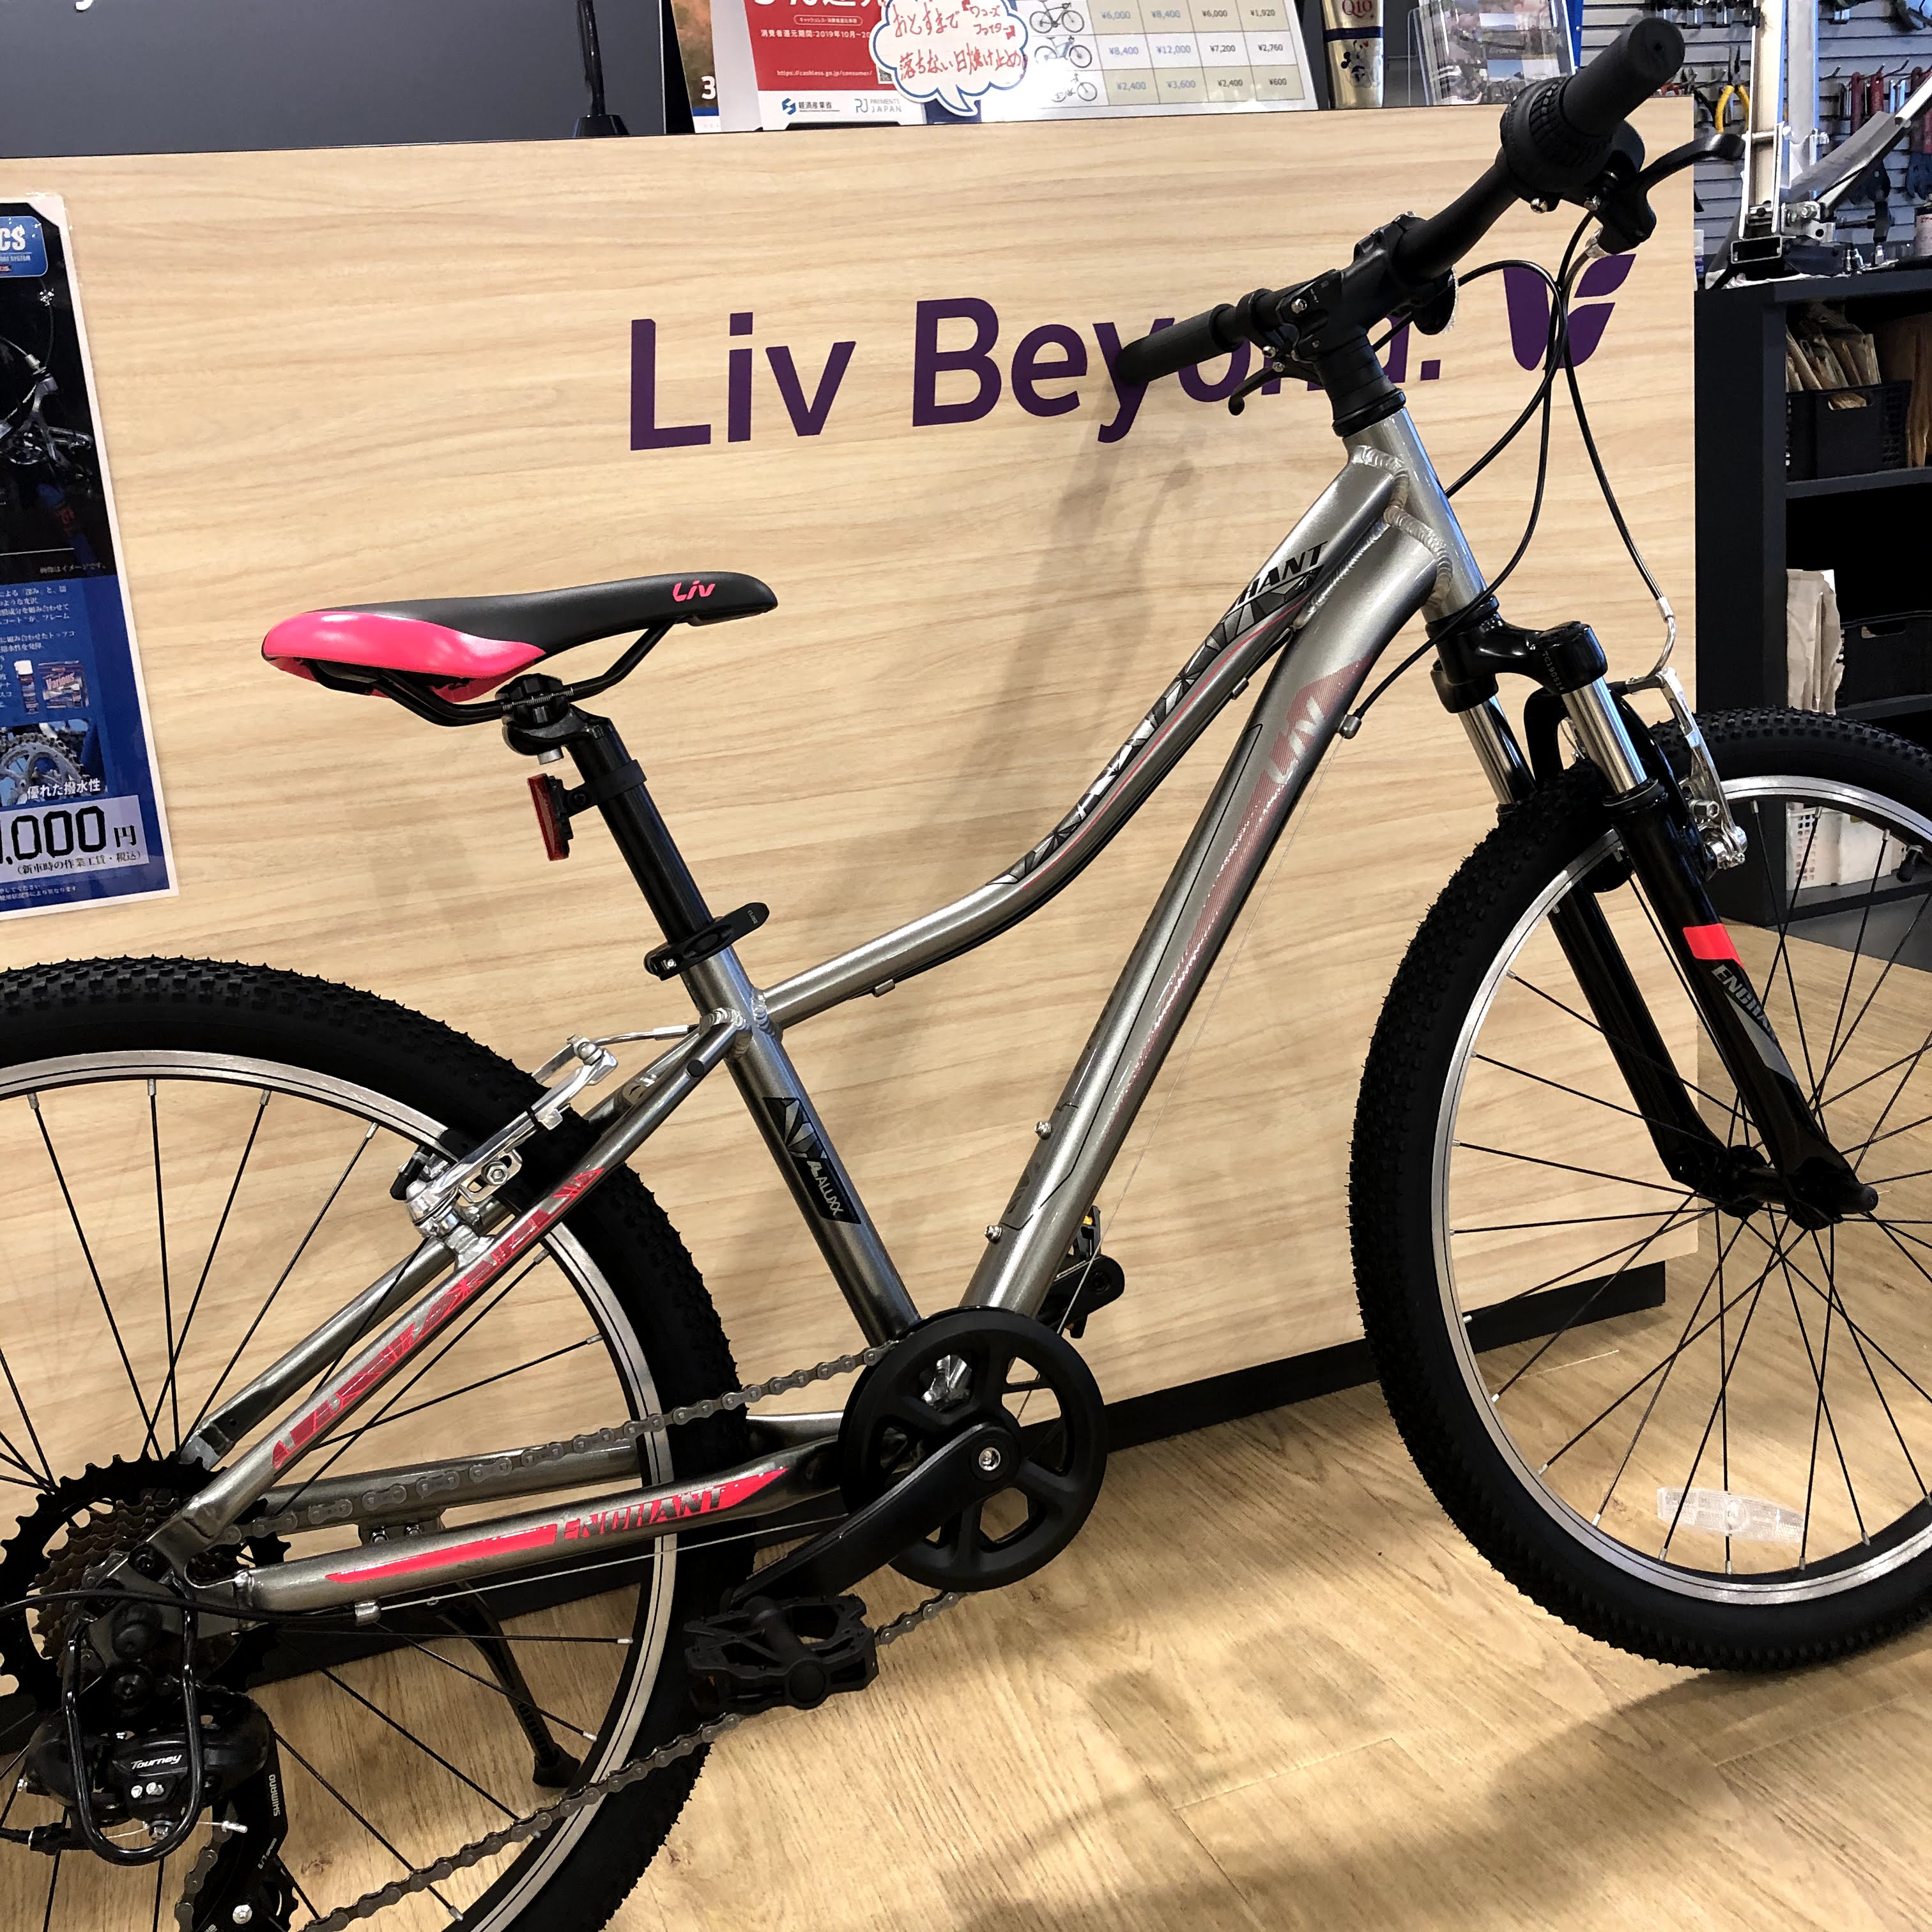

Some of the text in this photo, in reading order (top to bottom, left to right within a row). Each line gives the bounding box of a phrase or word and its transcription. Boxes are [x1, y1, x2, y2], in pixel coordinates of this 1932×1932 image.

[1100, 9, 1275, 20] ¥6,000 ¥8,400 ¥6,000 ¥1,920
[1108, 43, 1284, 56] ¥8,400 ¥12,000 ¥7,200 ¥2,760
[1116, 77, 1287, 91] ¥2,400 ¥3,600 ¥2,400 ¥600
[799, 101, 832, 109] 経済産業省
[630, 297, 1441, 451] Liv Beyo.
[673, 579, 716, 602] Liv
[27, 778, 101, 799] 優れた撥水性
[114, 825, 137, 848] 円
[555, 1486, 726, 1540] ENCHANT
[130, 1754, 182, 1770] Tourney
[268, 1774, 280, 1817] SHIMANO
